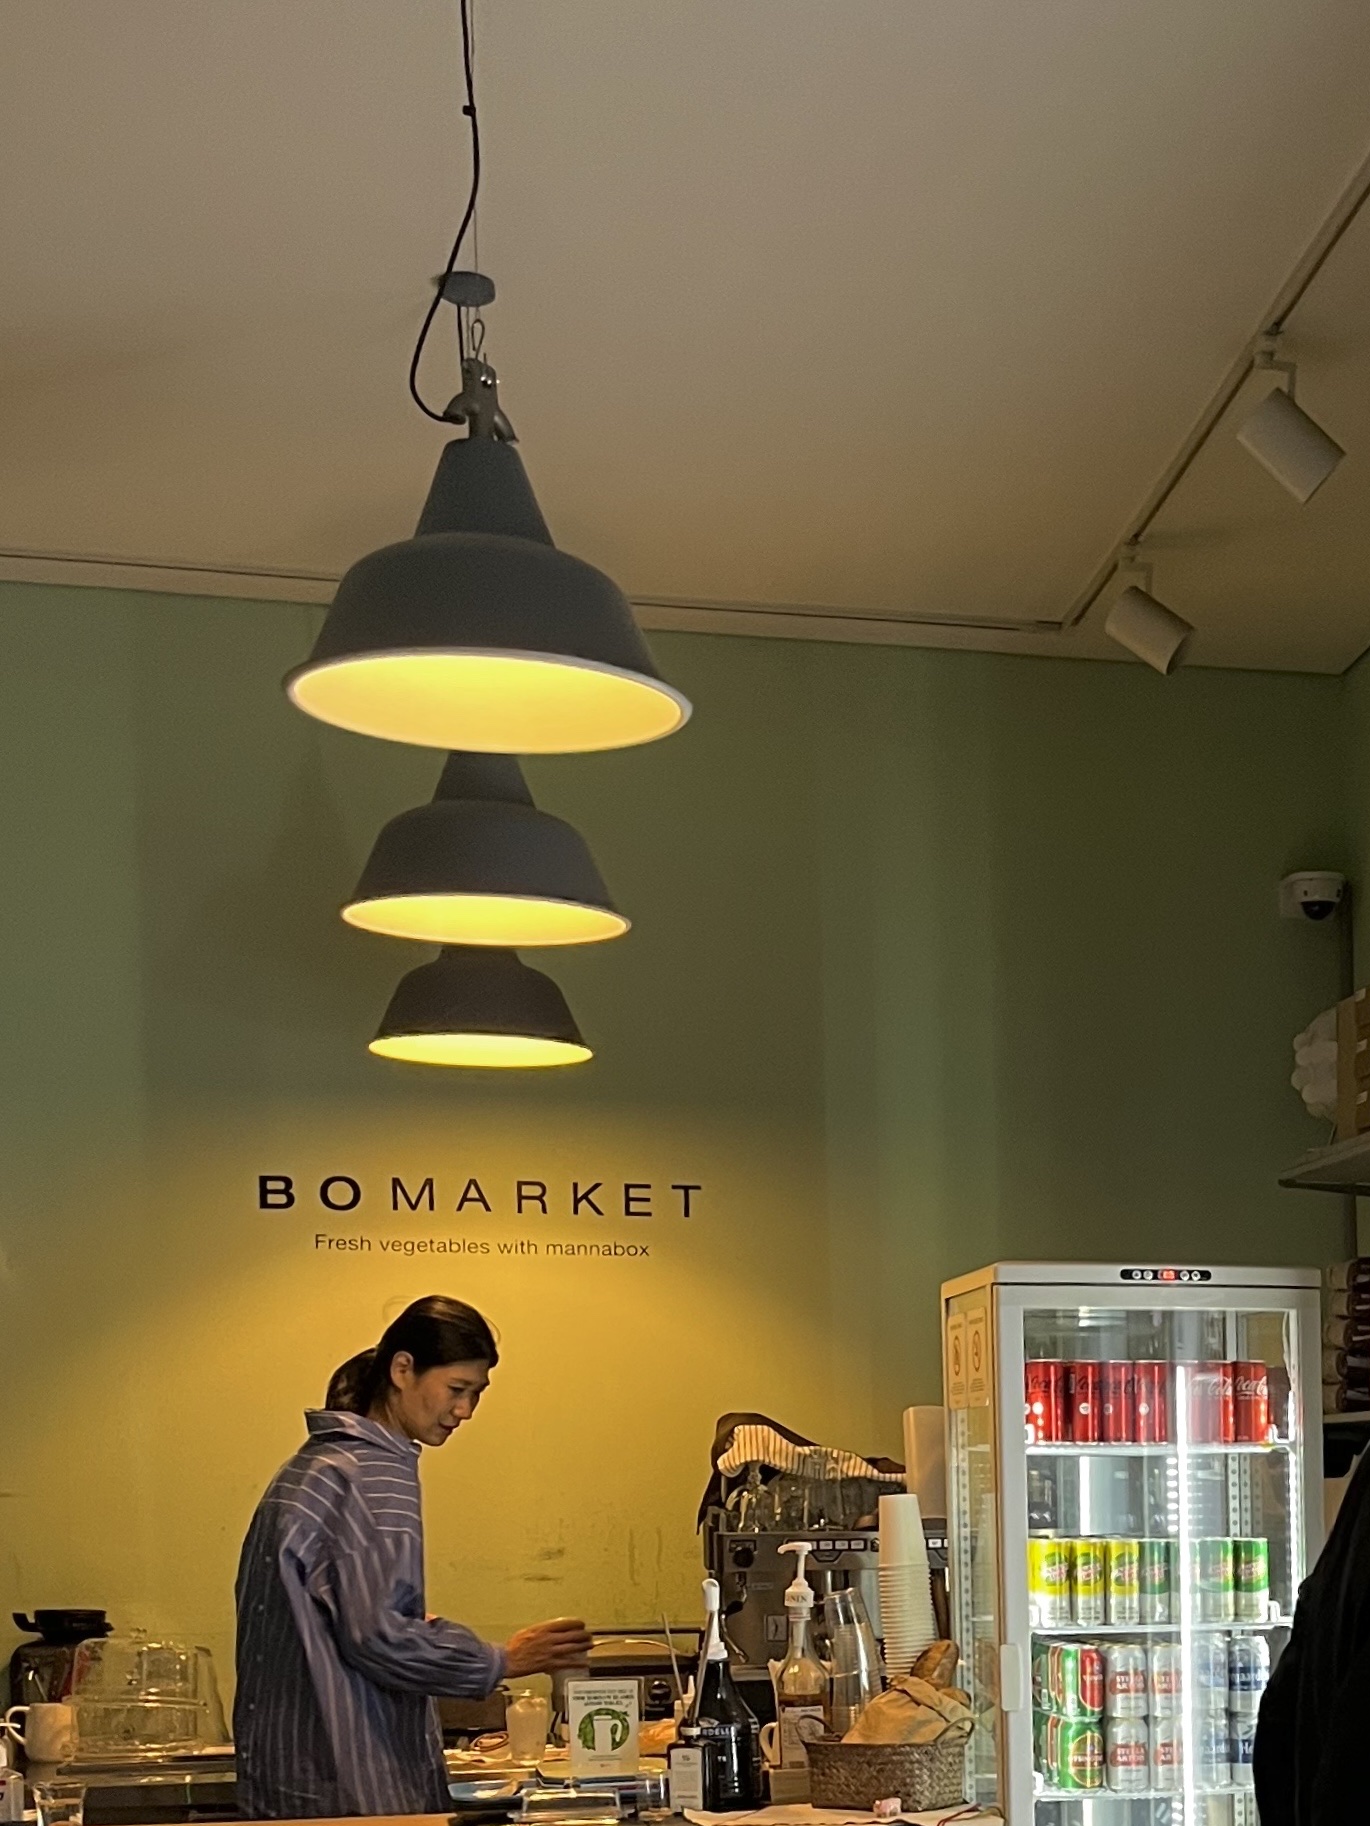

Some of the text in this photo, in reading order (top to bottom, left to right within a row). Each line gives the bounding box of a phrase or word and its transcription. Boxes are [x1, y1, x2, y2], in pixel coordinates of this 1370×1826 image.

[258, 1175, 703, 1218] BOMARKET
[314, 1233, 651, 1258] Fresh vegetables with mannabox
[1116, 1675, 1144, 1683] STELA
[1116, 1747, 1145, 1755] STELA
